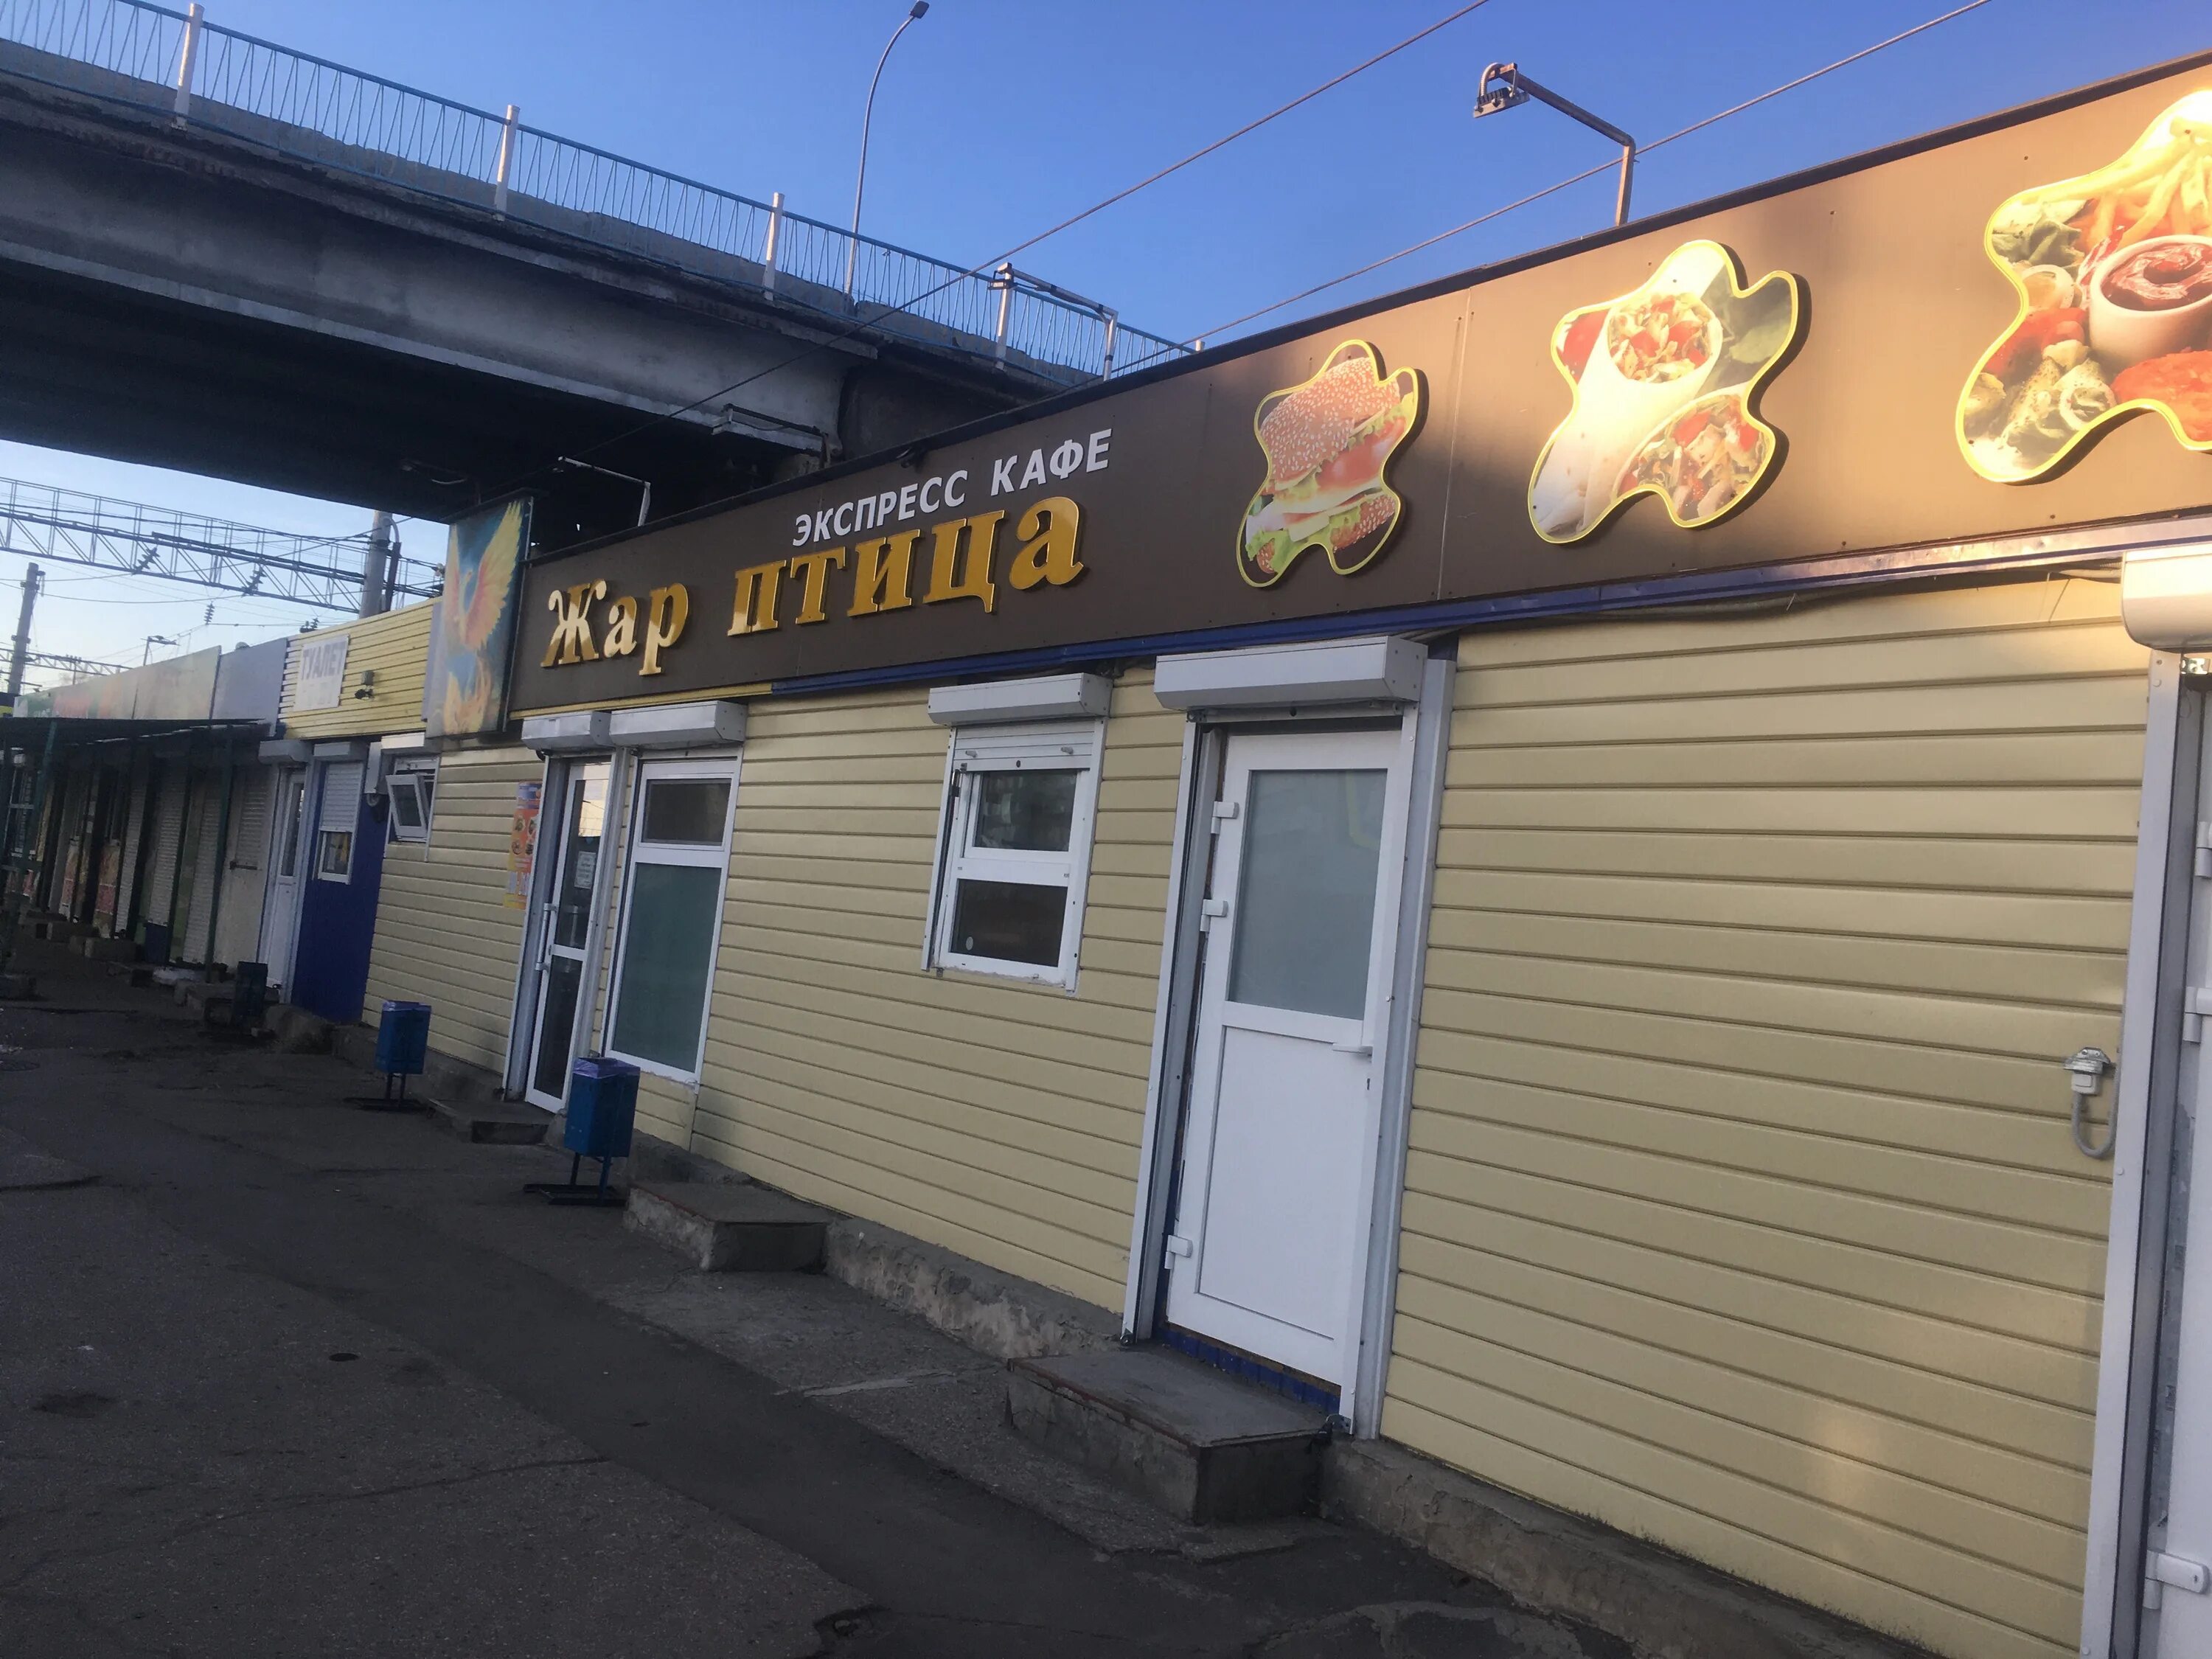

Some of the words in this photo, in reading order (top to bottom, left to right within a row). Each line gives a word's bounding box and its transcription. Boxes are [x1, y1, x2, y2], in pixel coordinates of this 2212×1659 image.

[792, 470, 969, 547] ЭКСПРЕСС
[991, 428, 1111, 495] КАФЕ
[540, 577, 689, 676] Жар
[727, 496, 1084, 636] птица
[302, 641, 347, 680] ТУАЛЕТ
